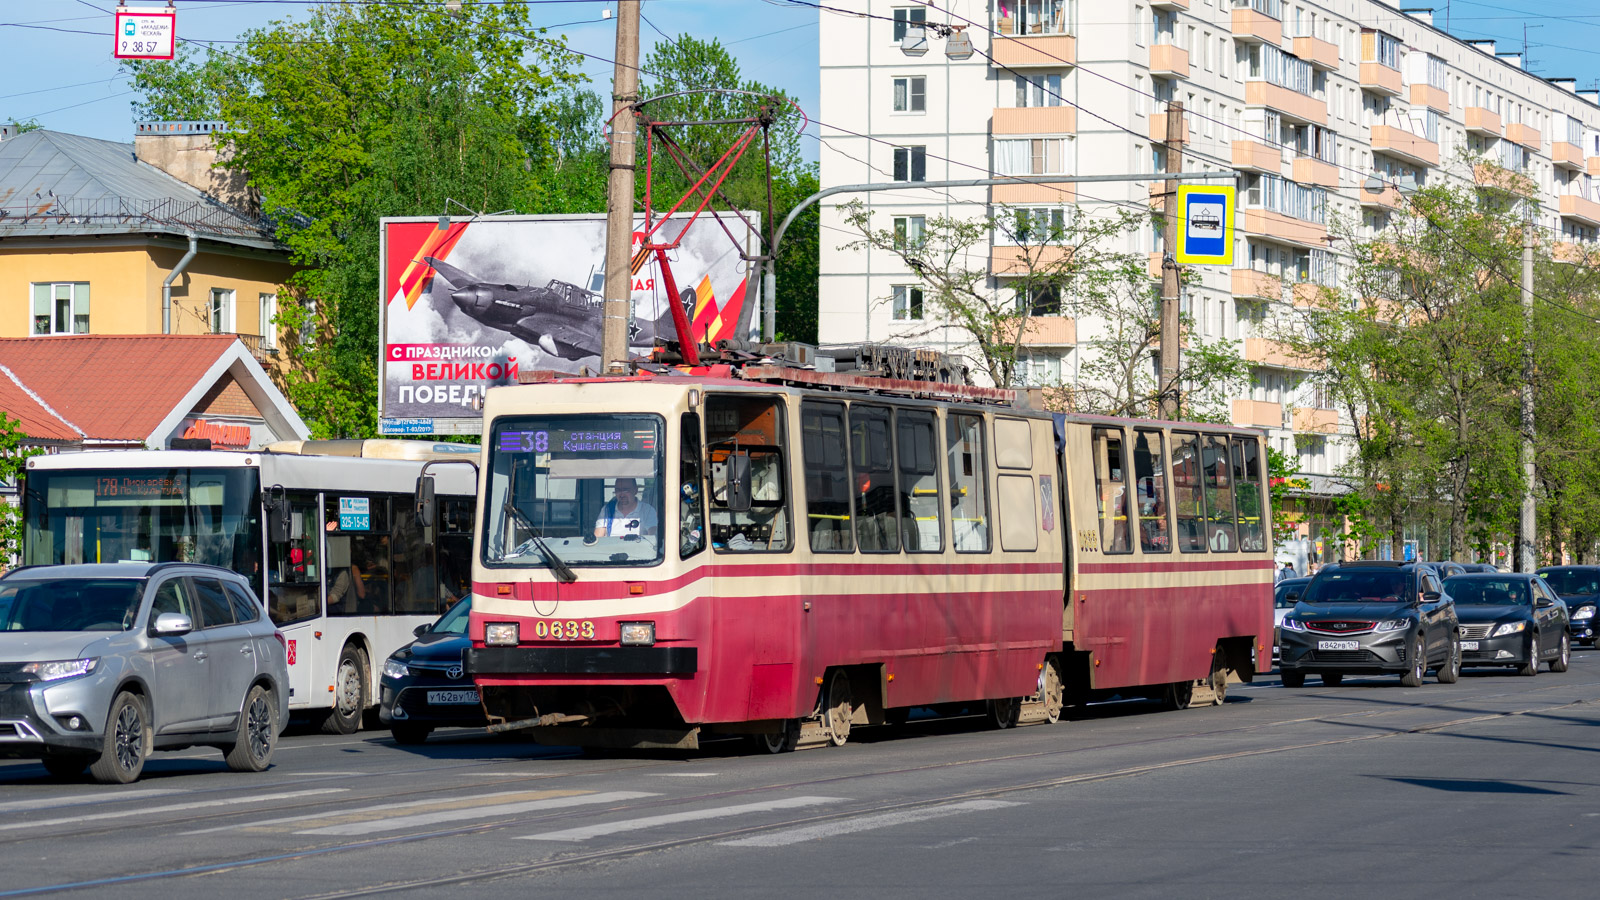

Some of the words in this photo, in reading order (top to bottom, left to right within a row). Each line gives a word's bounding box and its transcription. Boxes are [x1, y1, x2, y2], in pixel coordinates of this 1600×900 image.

[122, 41, 128, 52] 9
[132, 41, 143, 53] 38
[146, 41, 158, 53] 57
[391, 346, 403, 358] С
[405, 346, 504, 360] ПРАЗДНИКОМ
[412, 356, 519, 381] ВЕЛИКОЙ
[520, 431, 549, 453] 38
[570, 431, 622, 441] станция
[562, 440, 628, 452] Кушелевка
[96, 478, 118, 496] 178
[341, 516, 369, 528] 325-15-45
[535, 620, 595, 639] 0633
[430, 692, 464, 702] У162ВУ
